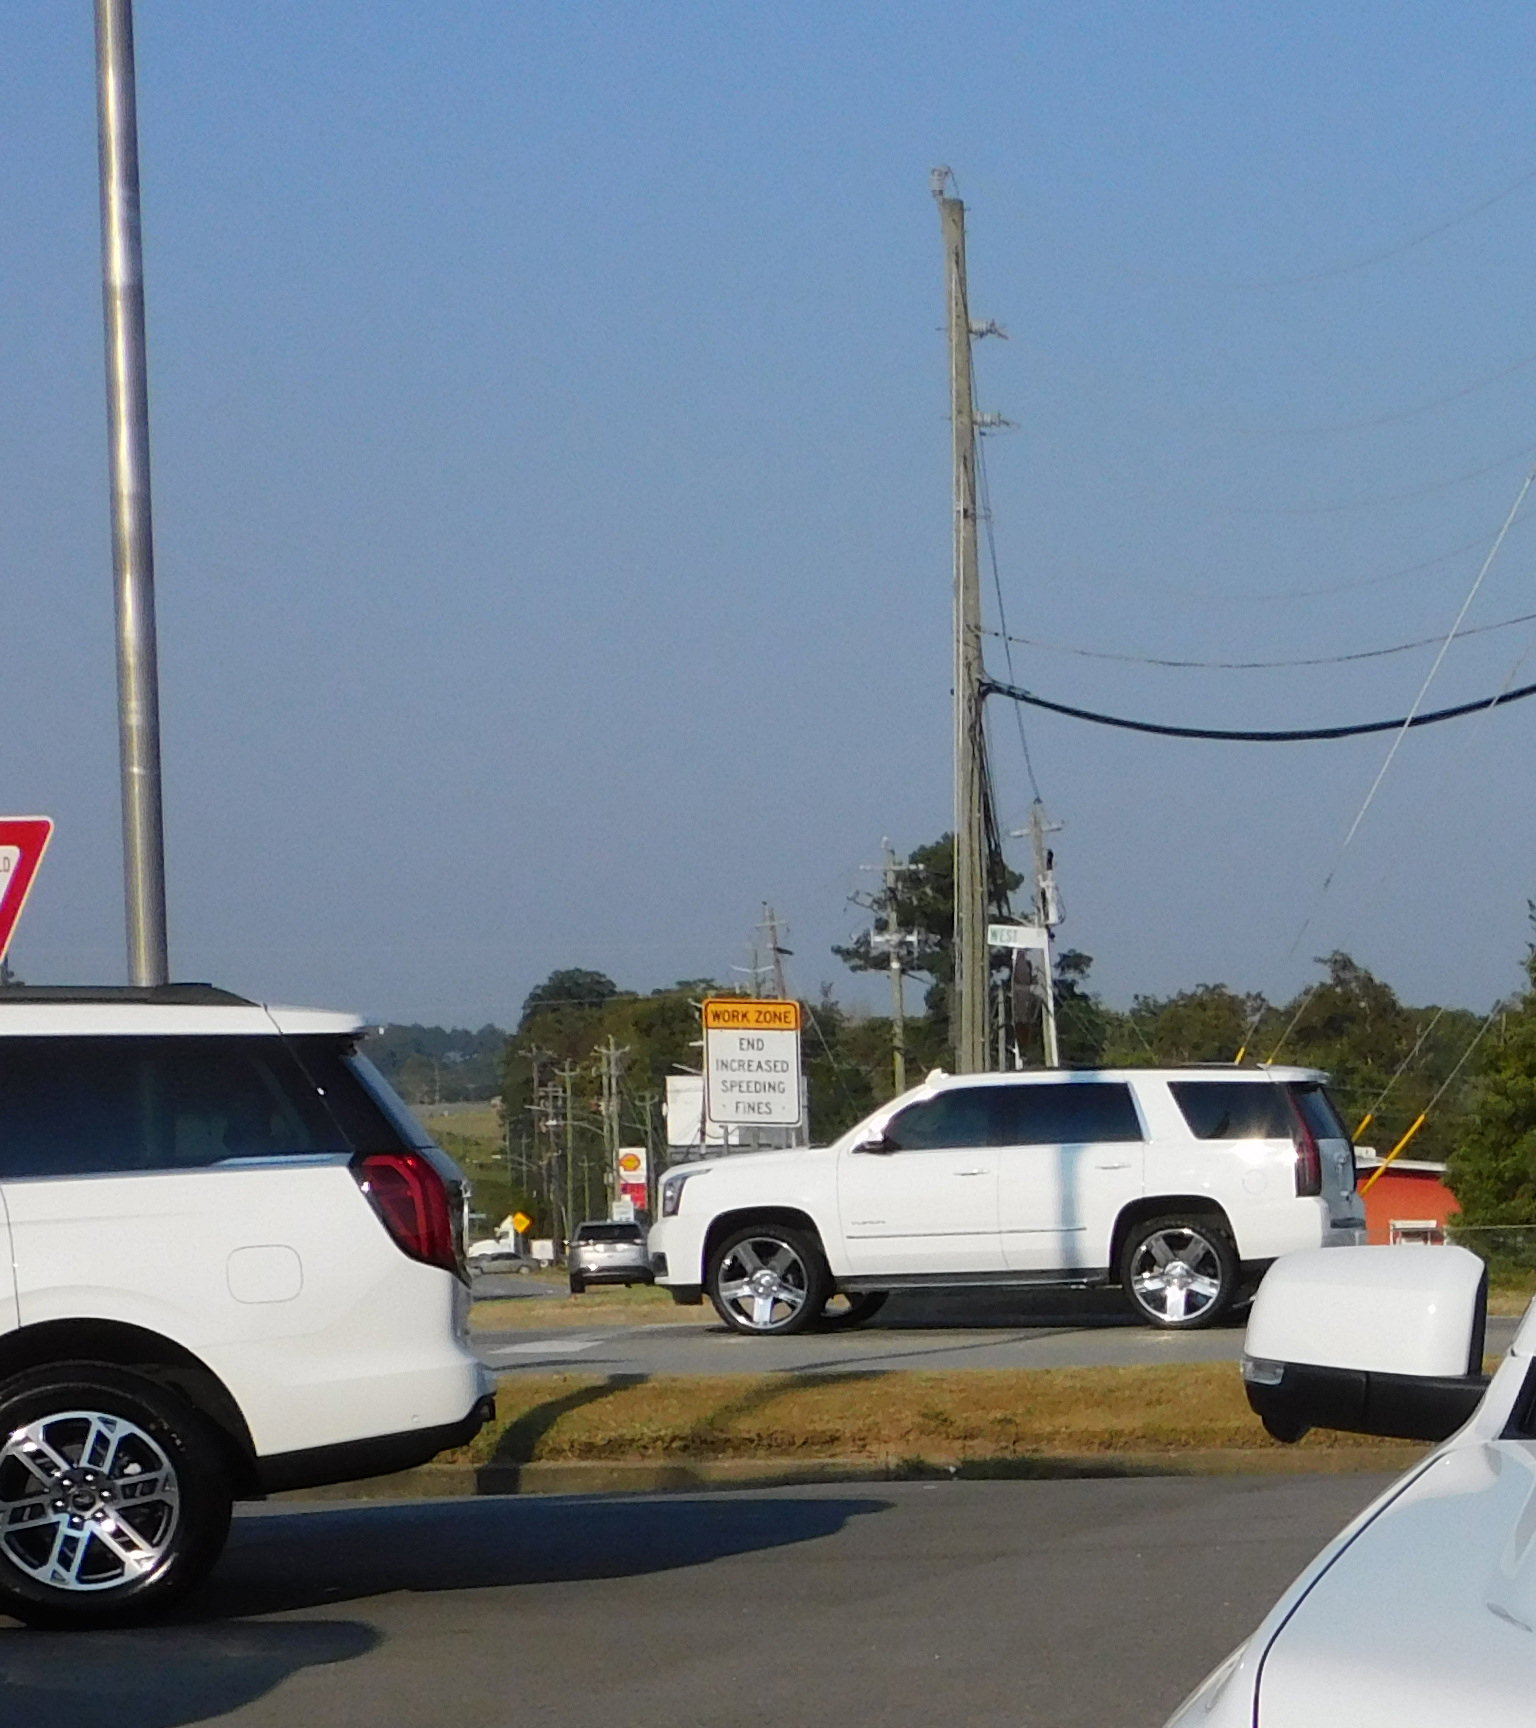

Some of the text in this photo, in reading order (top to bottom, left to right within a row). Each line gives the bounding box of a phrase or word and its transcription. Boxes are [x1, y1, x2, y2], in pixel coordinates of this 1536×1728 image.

[711, 1010, 792, 1024] WORK ZONE
[738, 1037, 765, 1052] END
[715, 1058, 790, 1073] INCREASED
[721, 1079, 786, 1094] SPEEDING
[735, 1101, 773, 1115] FINES
